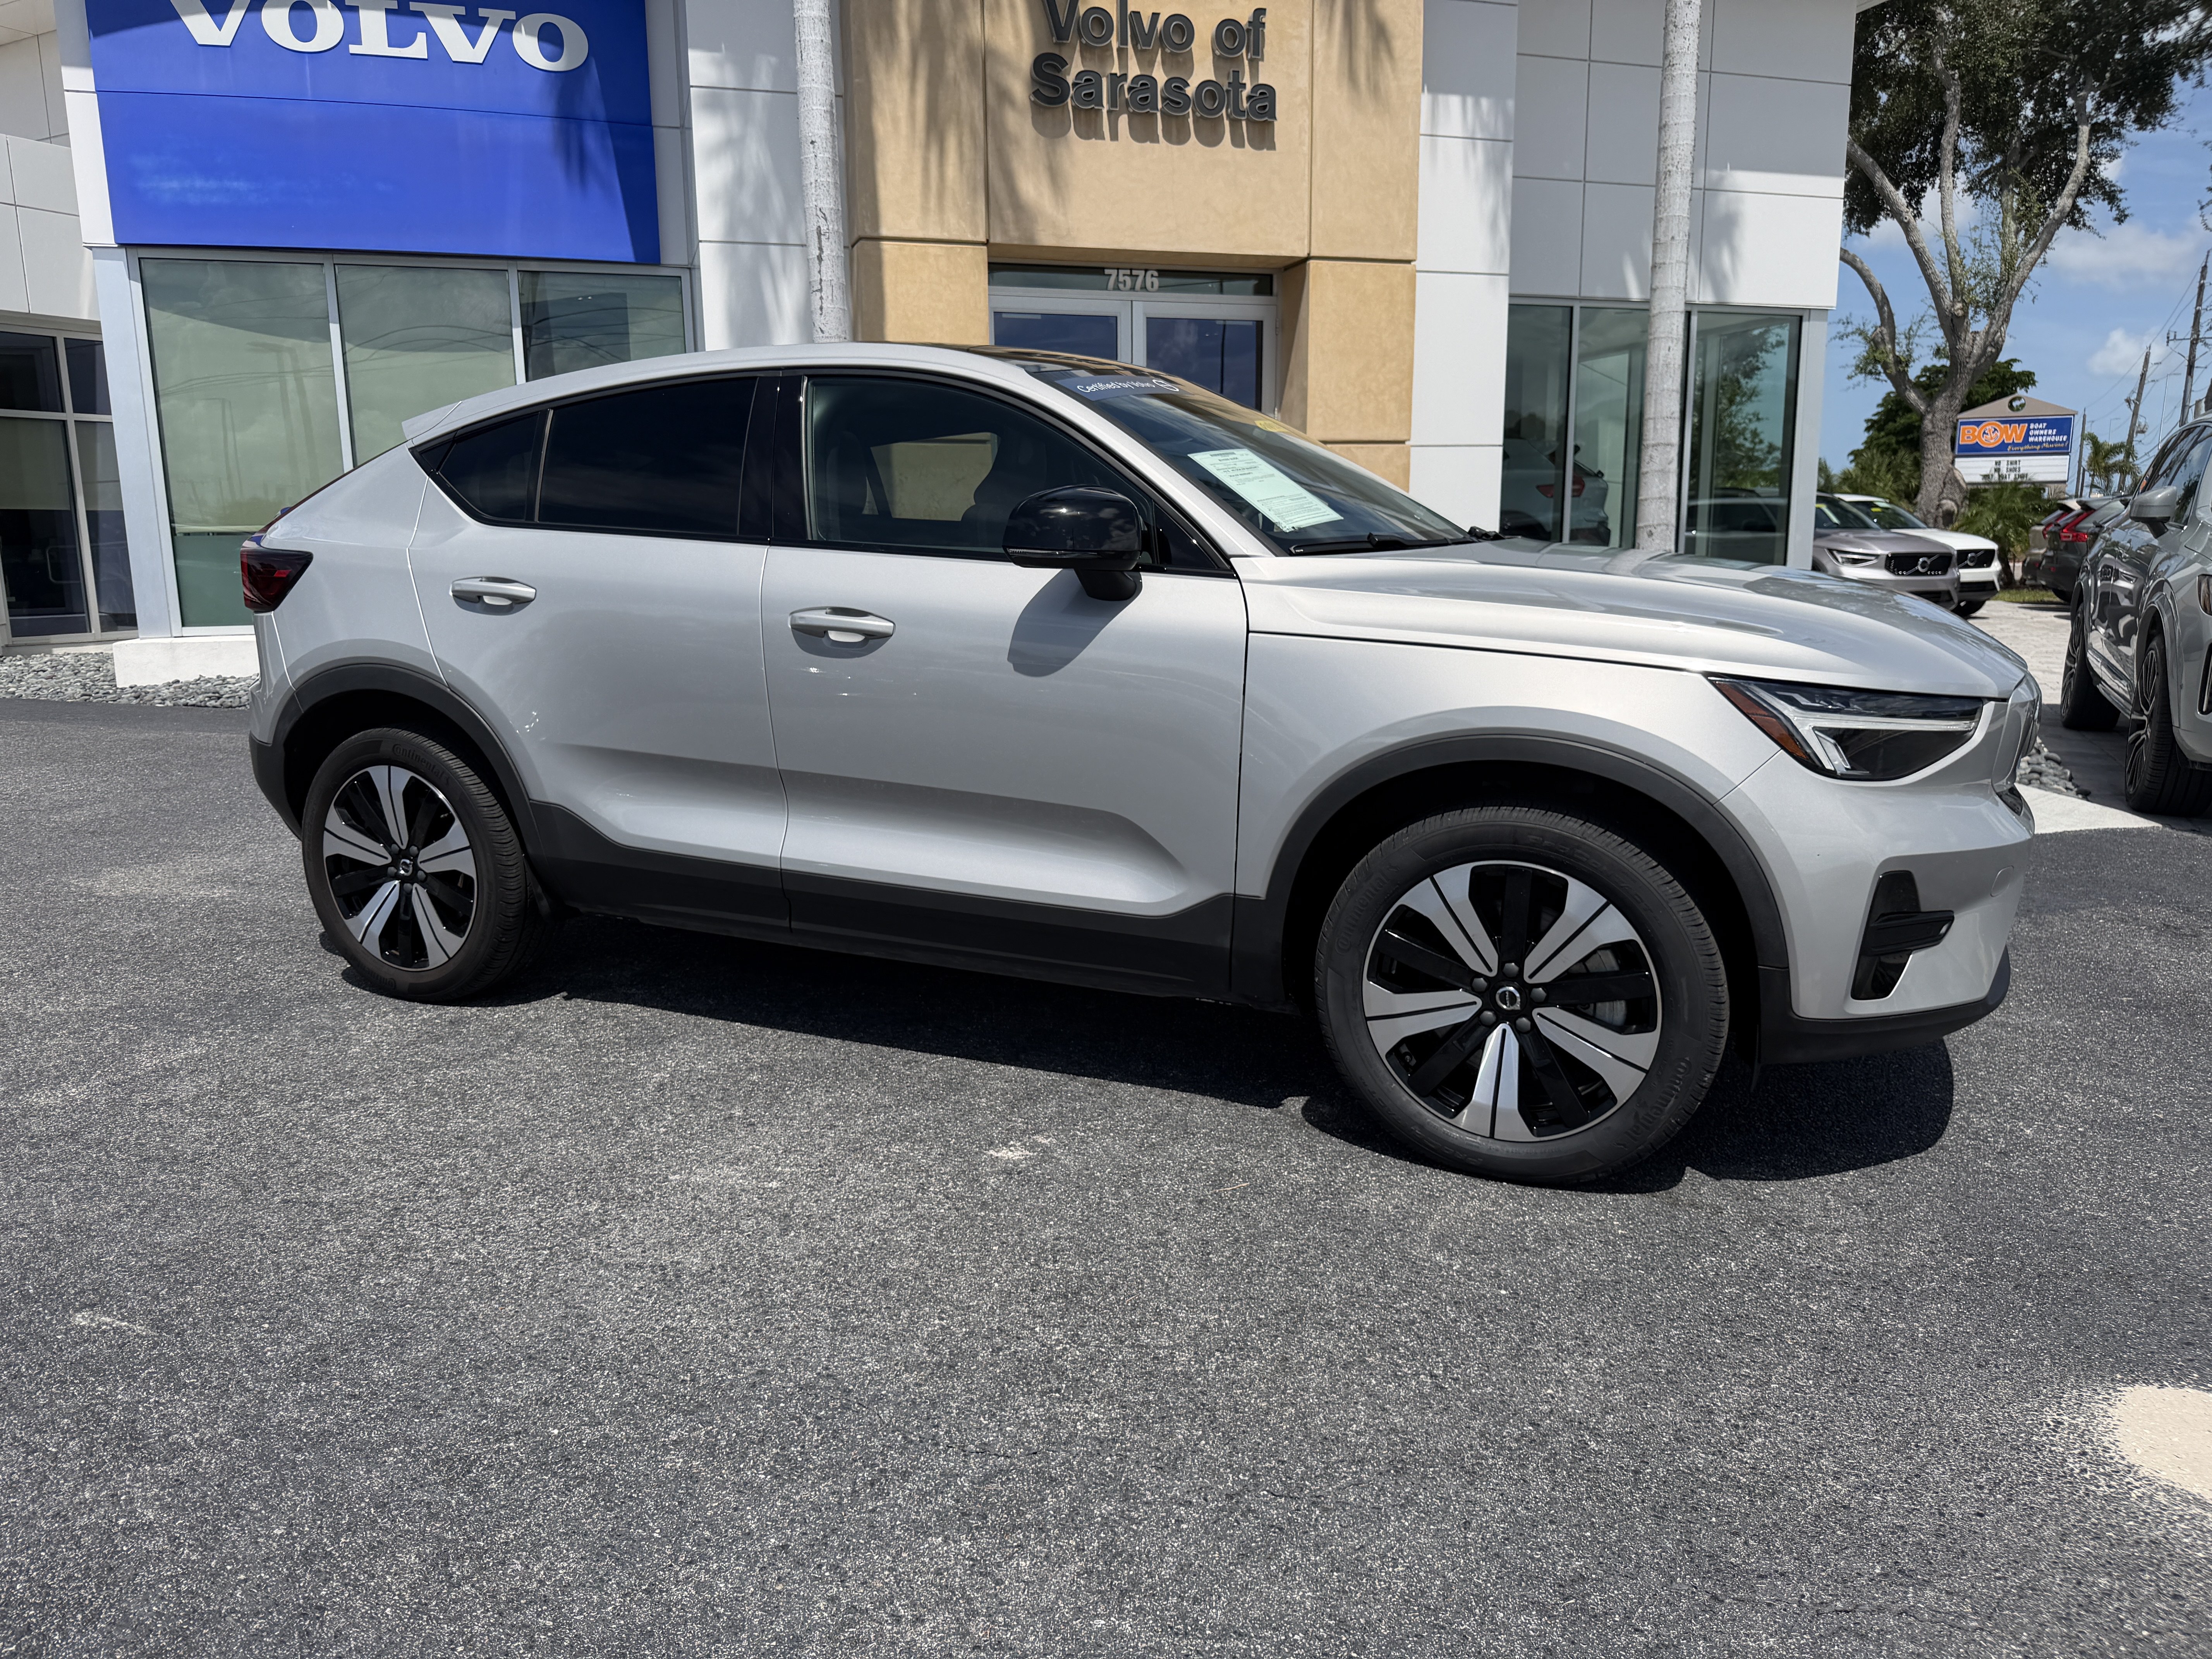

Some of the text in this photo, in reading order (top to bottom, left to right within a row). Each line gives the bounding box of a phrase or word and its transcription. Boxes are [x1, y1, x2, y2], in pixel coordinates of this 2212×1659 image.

[169, 0, 589, 72] VOLVO
[1044, 0, 1267, 60] Volvo of
[1029, 52, 1277, 122] Sarasota
[1104, 268, 1159, 292] 7576
[1077, 381, 1121, 392] Certified
[1960, 421, 2027, 448] BOW
[392, 743, 443, 780] Continental
[1334, 870, 1391, 956] Continental
[1626, 1056, 1692, 1144] Continental
